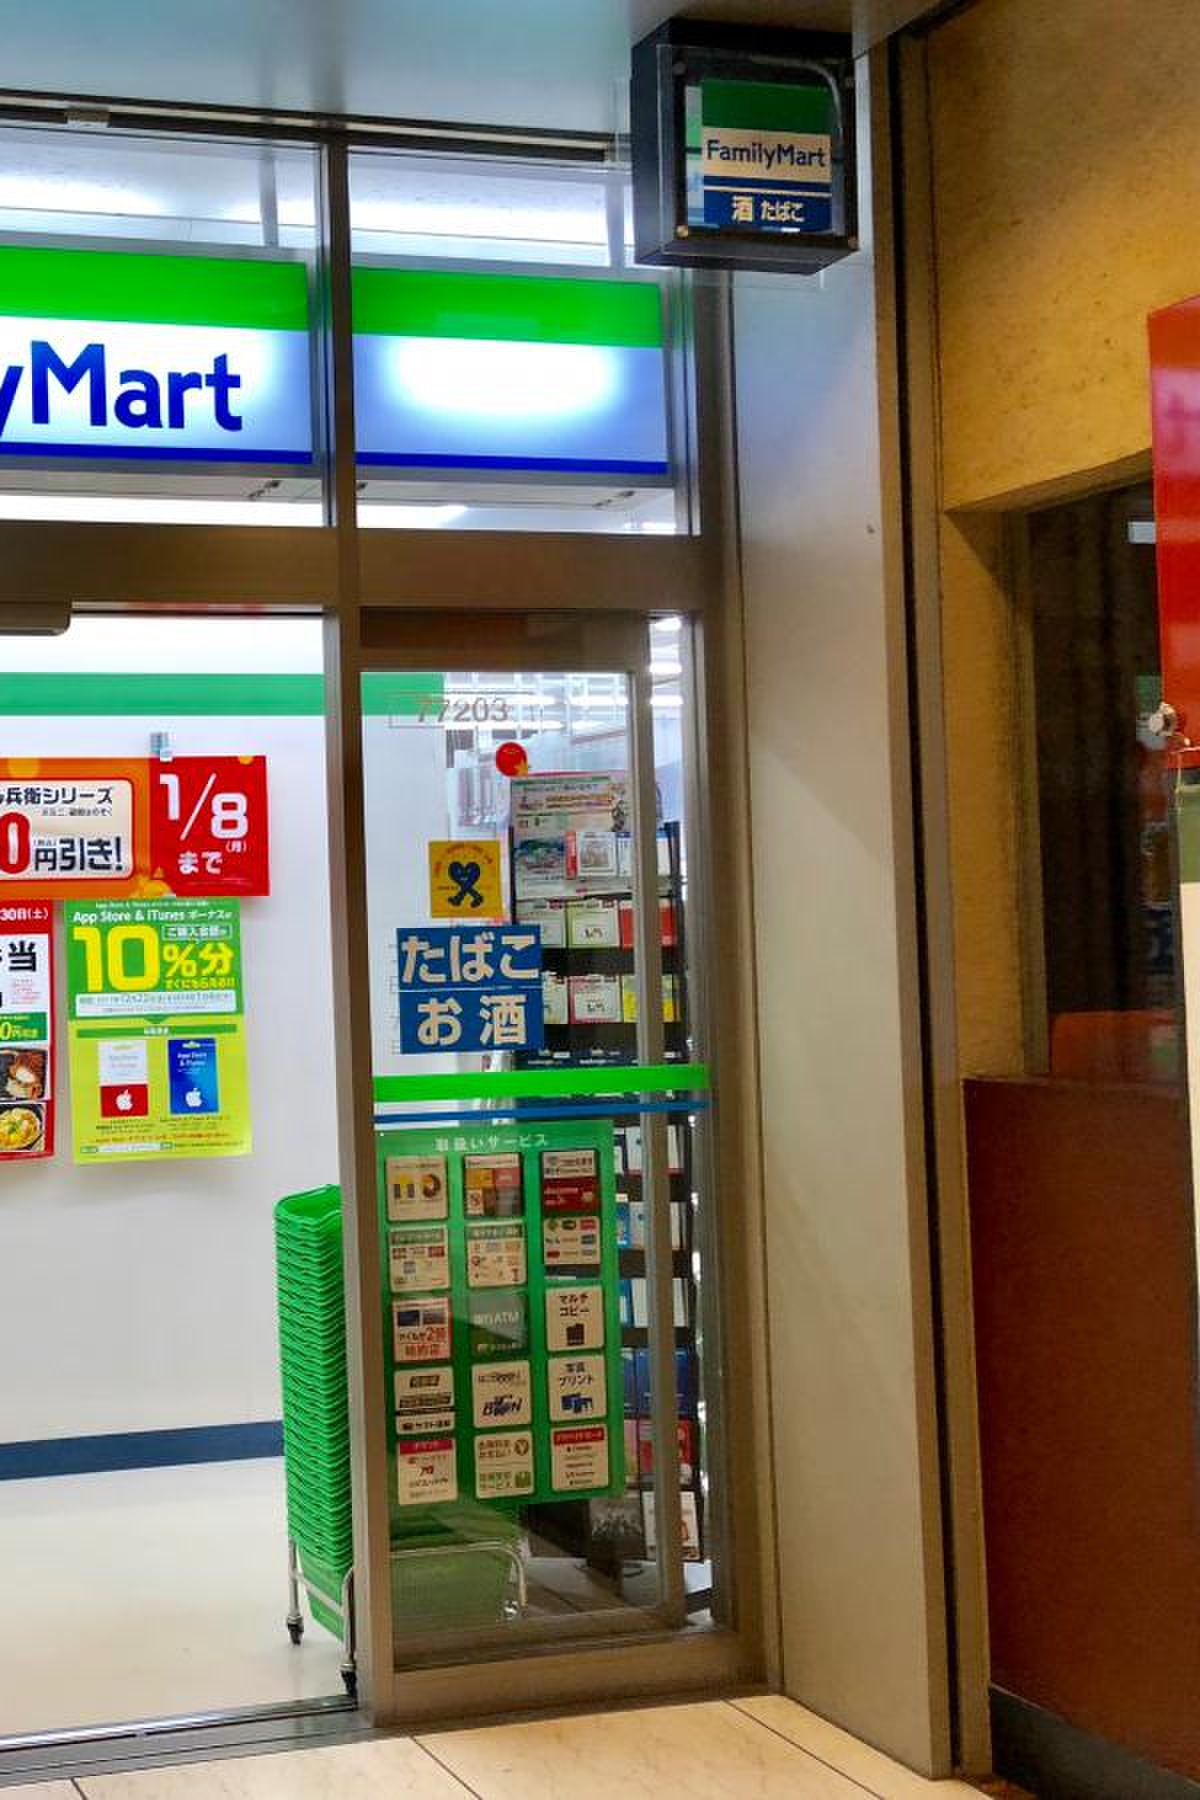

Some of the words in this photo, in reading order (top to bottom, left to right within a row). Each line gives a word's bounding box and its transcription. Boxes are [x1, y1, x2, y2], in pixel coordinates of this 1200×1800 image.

[707, 138, 826, 169] FamilyMart
[732, 195, 754, 222] 酒
[761, 200, 805, 223] たばこ
[159, 772, 249, 841] 1/8
[178, 850, 223, 875] まで
[73, 911, 97, 926] App
[100, 910, 132, 923] Store
[402, 931, 540, 983] たばこ
[417, 995, 527, 1046] お酒
